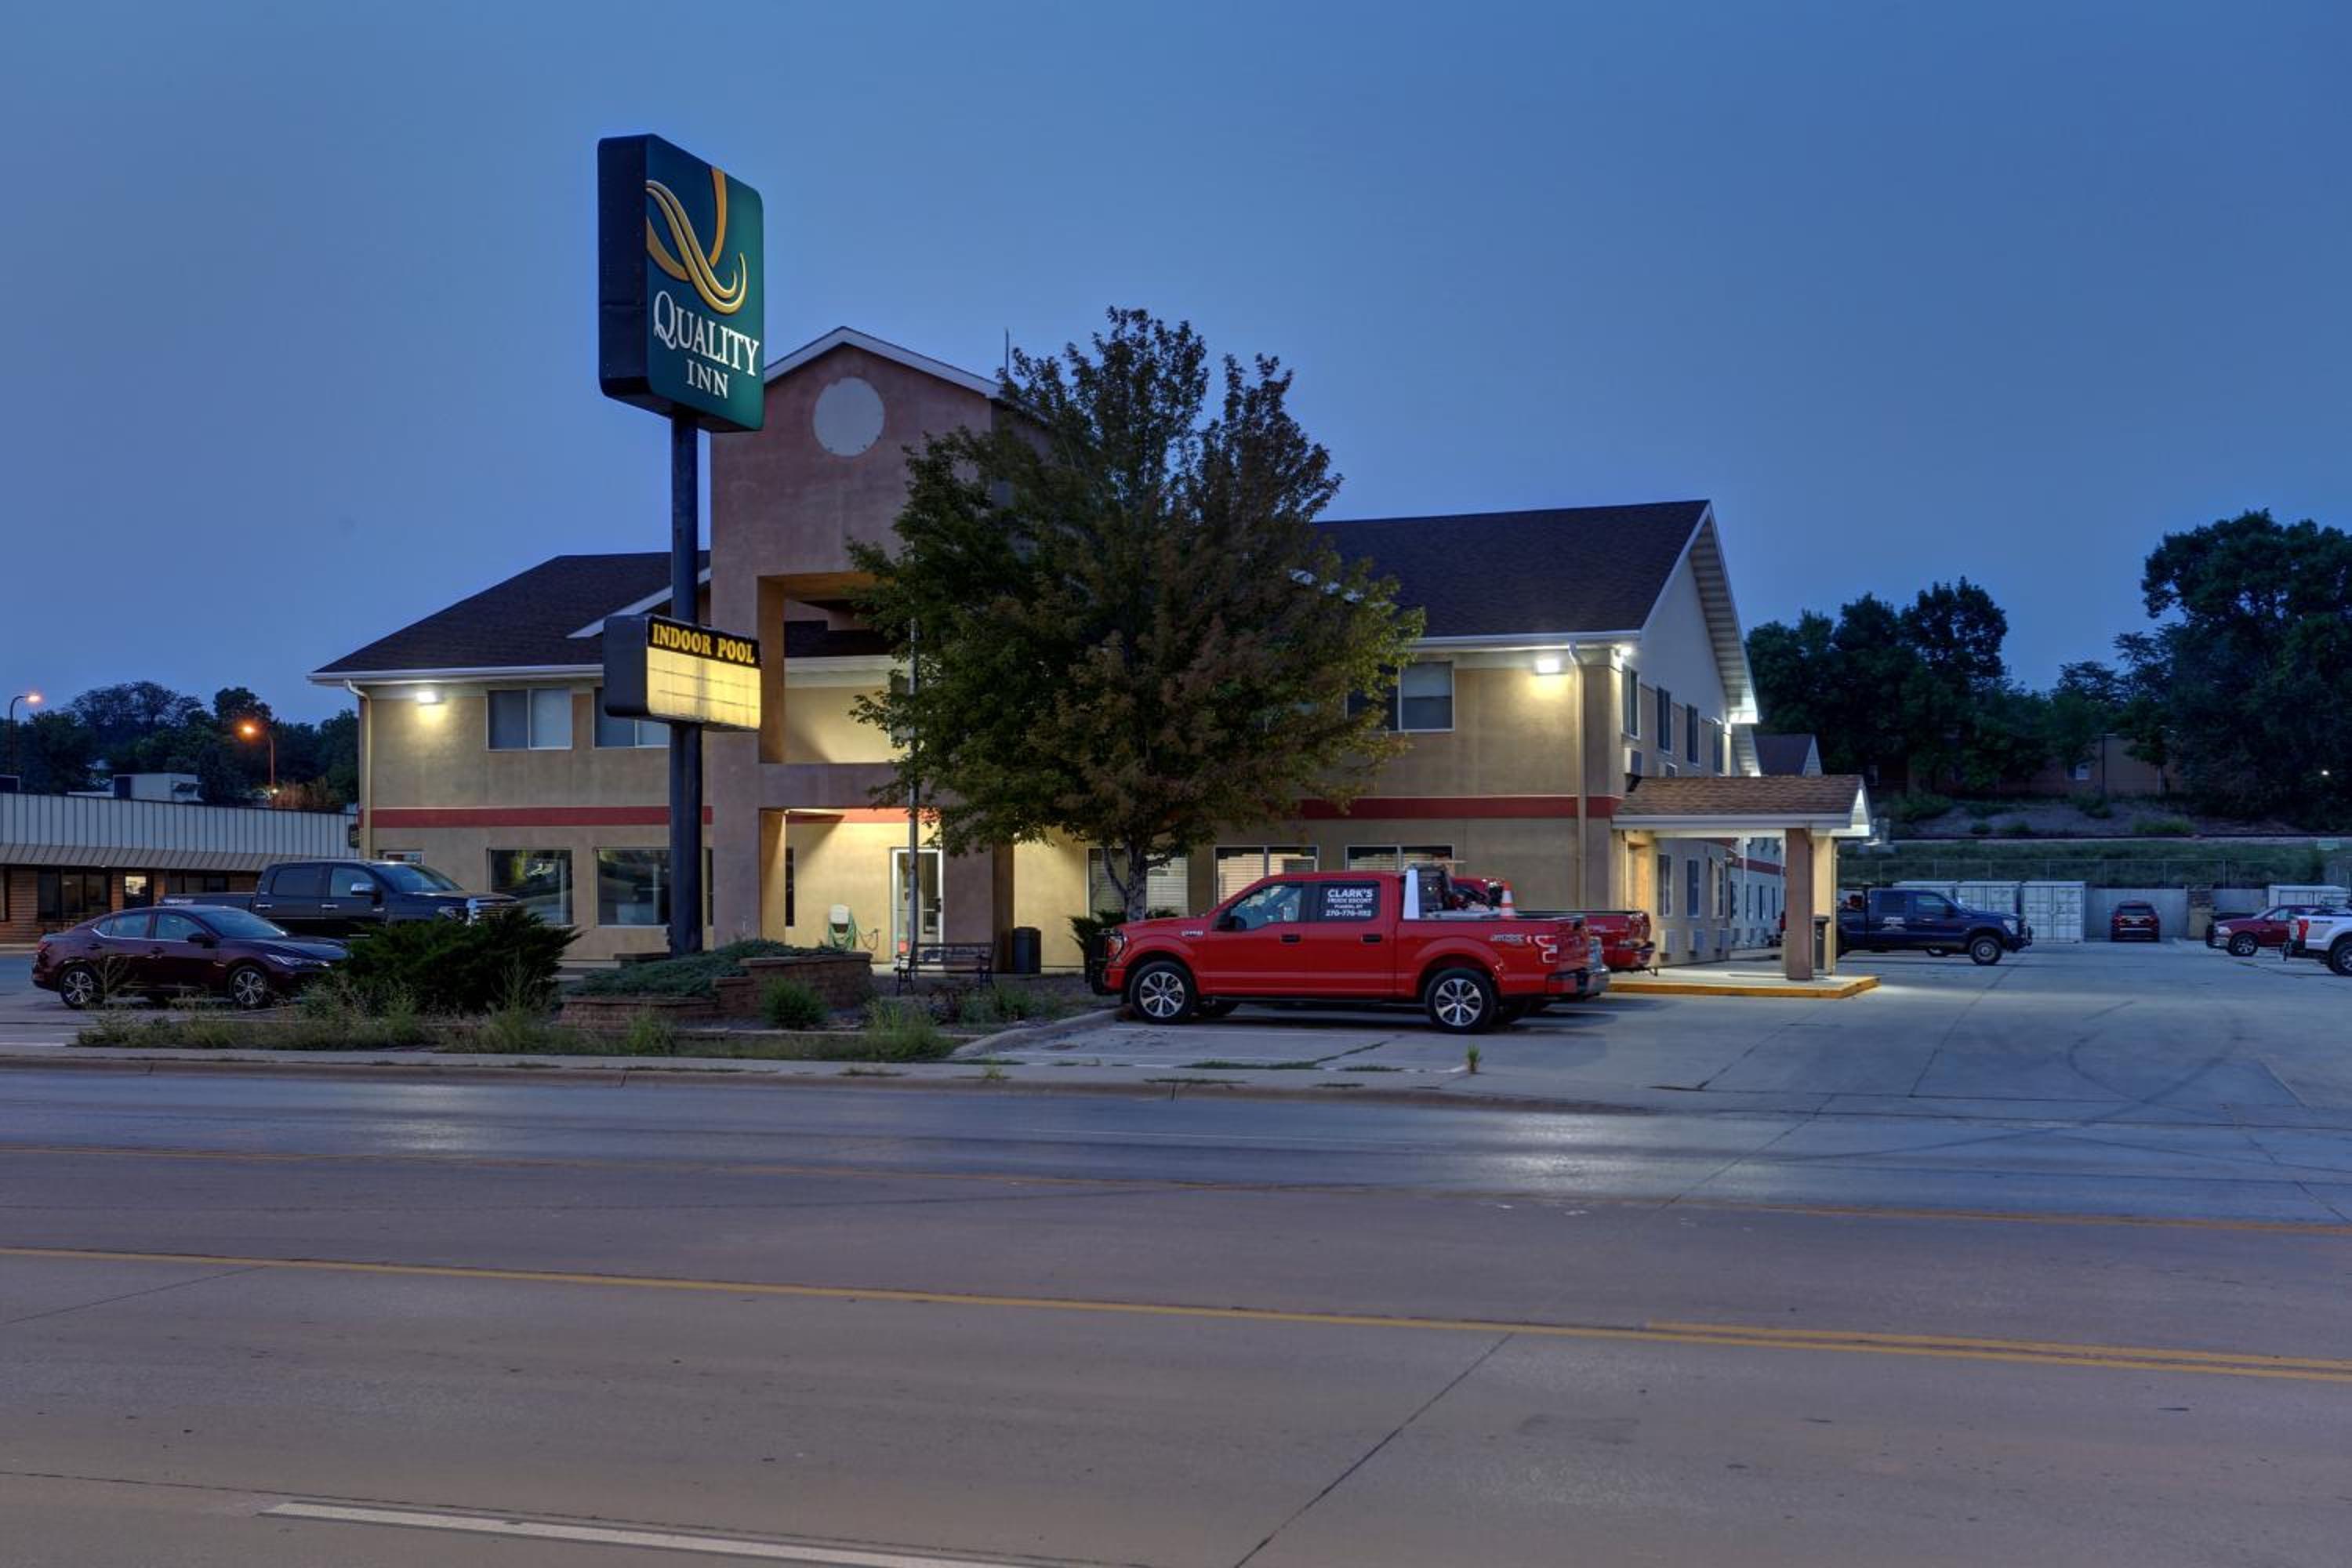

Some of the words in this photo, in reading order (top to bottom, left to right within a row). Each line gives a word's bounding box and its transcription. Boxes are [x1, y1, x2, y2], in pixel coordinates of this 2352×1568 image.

[653, 290, 760, 376] QUALITY
[687, 359, 728, 398] INN
[652, 624, 712, 655] INDOOR
[717, 638, 755, 664] POOL
